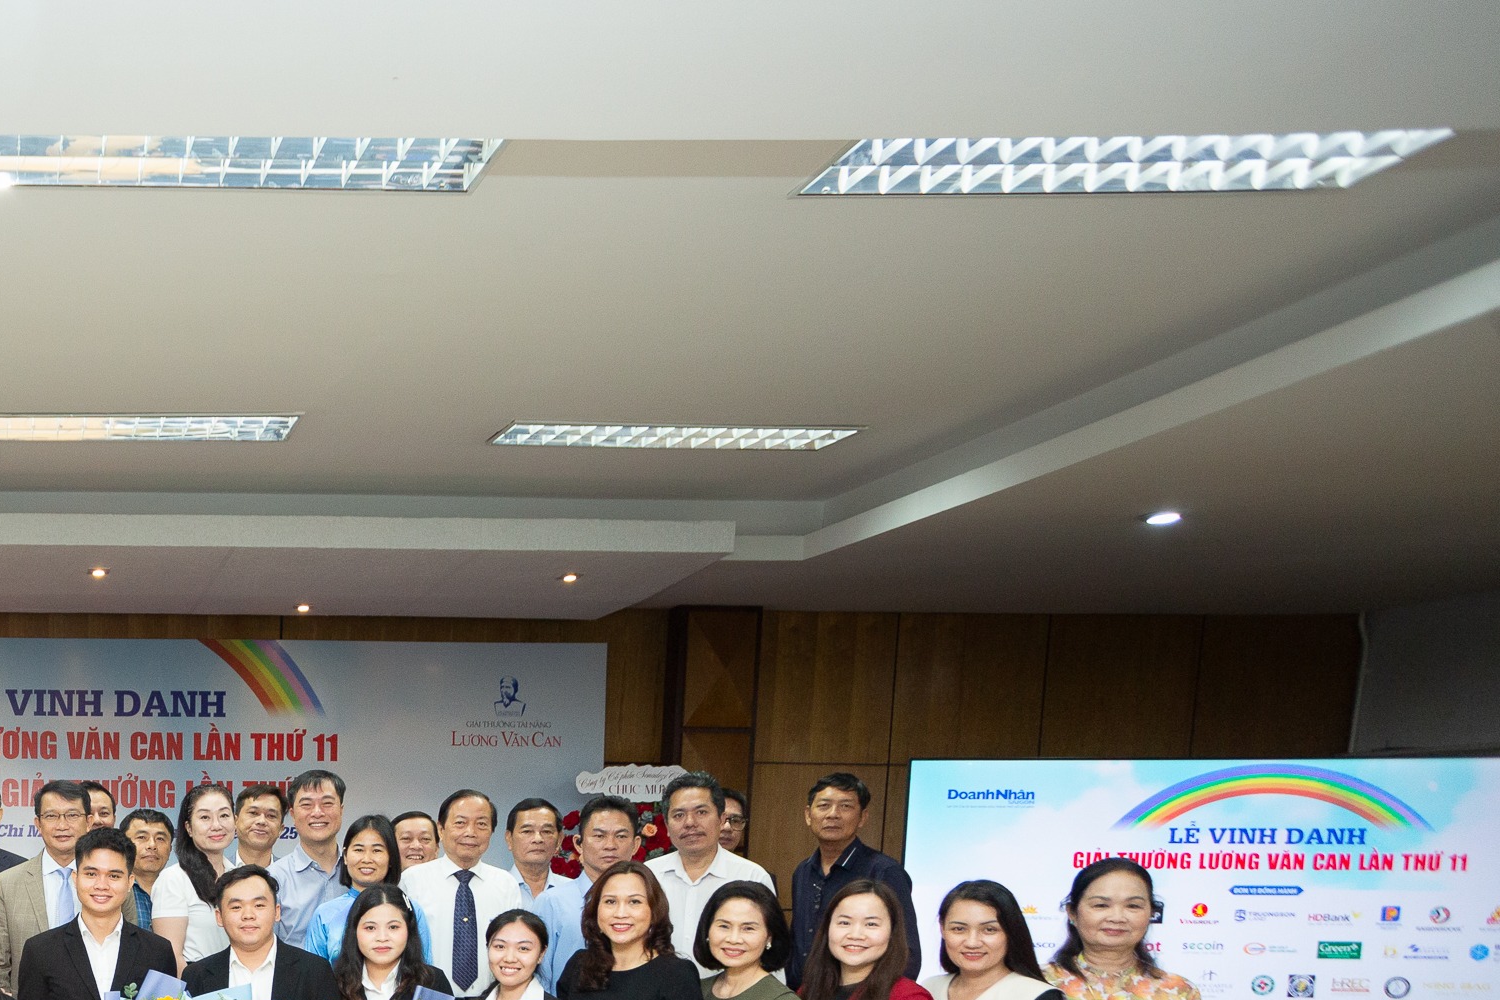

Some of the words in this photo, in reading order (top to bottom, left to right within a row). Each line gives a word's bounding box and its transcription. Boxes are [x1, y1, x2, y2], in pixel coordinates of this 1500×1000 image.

[5, 689, 103, 717] VINH
[114, 690, 227, 718] DANH
[67, 727, 120, 760] VĂN
[130, 731, 183, 761] CAN
[193, 723, 241, 761] LẦN
[250, 729, 306, 762] THỨ
[313, 733, 338, 762] 11
[451, 731, 498, 747] LƯƠNG
[500, 731, 529, 747] VĂN
[531, 731, 562, 748] CAN
[947, 789, 1035, 800] DoanhNhân
[1168, 821, 1199, 844] LỄ
[1209, 828, 1277, 844] VINH
[1285, 828, 1367, 845] DANH
[1199, 849, 1260, 870] LƯƠNG
[1268, 851, 1304, 870] VĂN
[1312, 853, 1351, 871] CAN
[1358, 847, 1394, 871] LẦN
[1449, 853, 1468, 871] 11
[1308, 913, 1351, 923] HDBank
[1182, 941, 1224, 950] secoin
